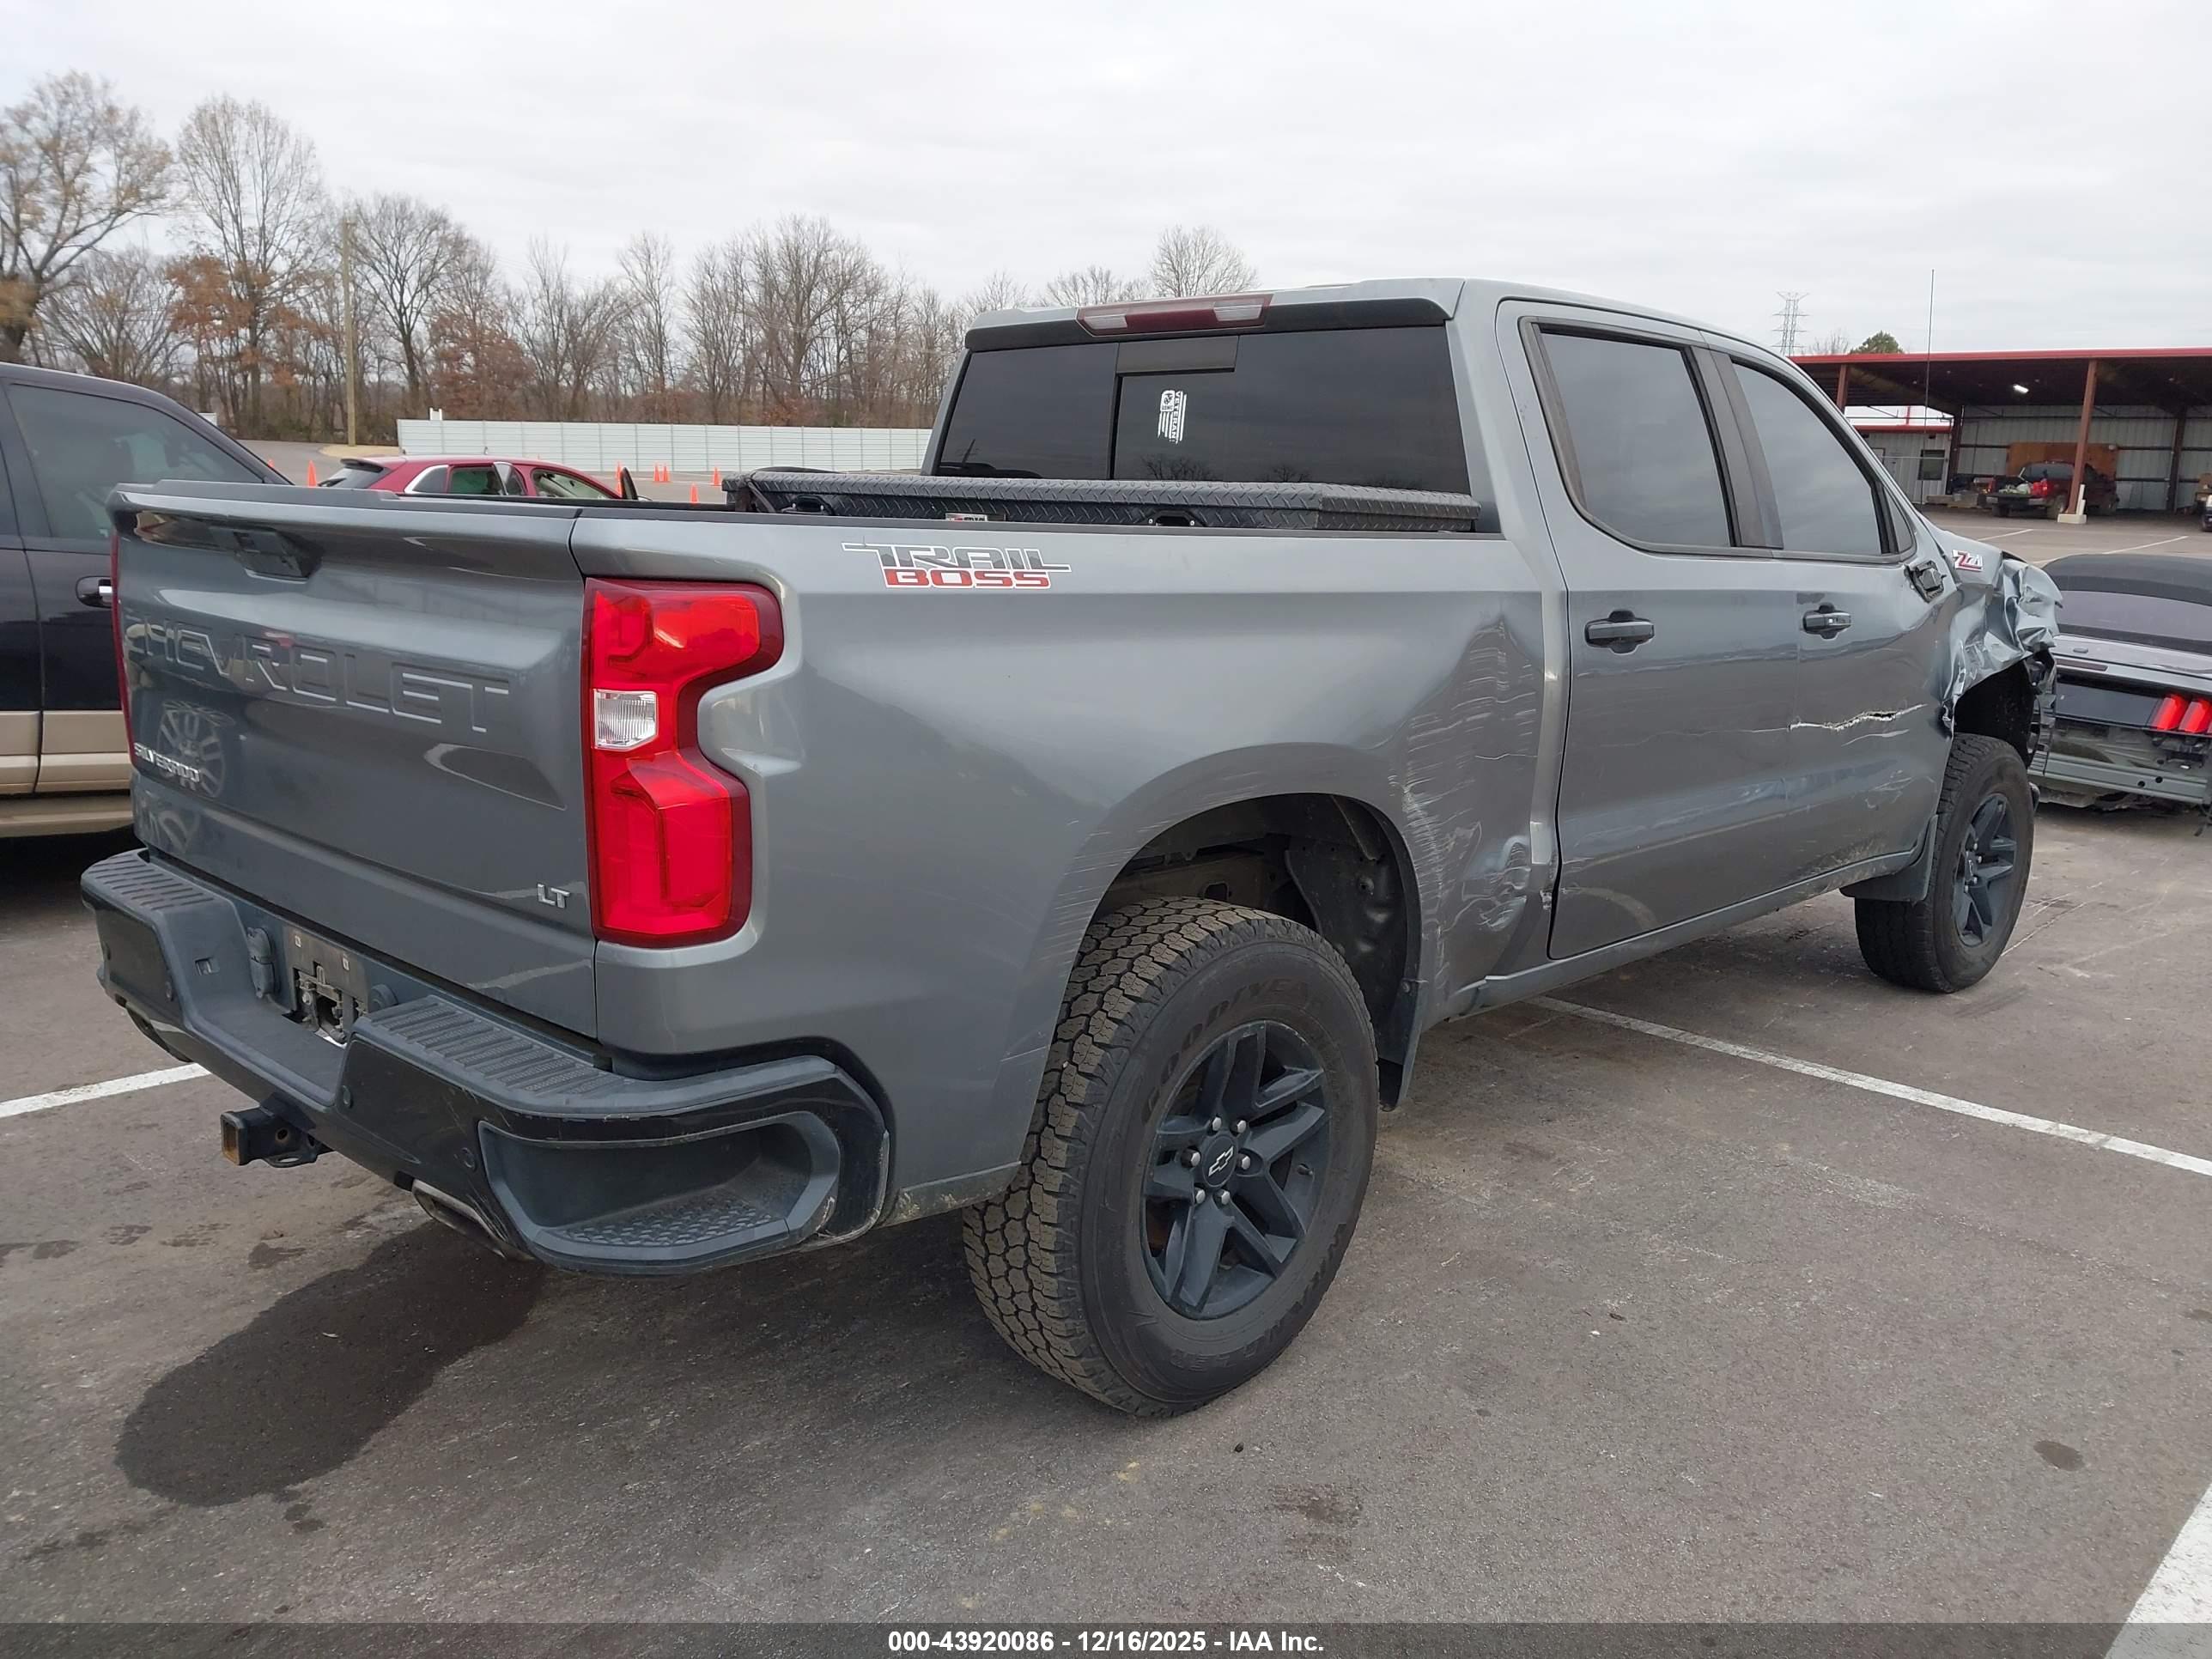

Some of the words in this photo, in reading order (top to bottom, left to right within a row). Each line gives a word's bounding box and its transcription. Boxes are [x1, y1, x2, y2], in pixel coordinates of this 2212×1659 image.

[842, 542, 1072, 572] TRAIL
[883, 568, 1051, 588] BOSS
[124, 611, 510, 733] CHEVROLET
[134, 742, 200, 783] SILVERADO
[537, 883, 571, 908] LT
